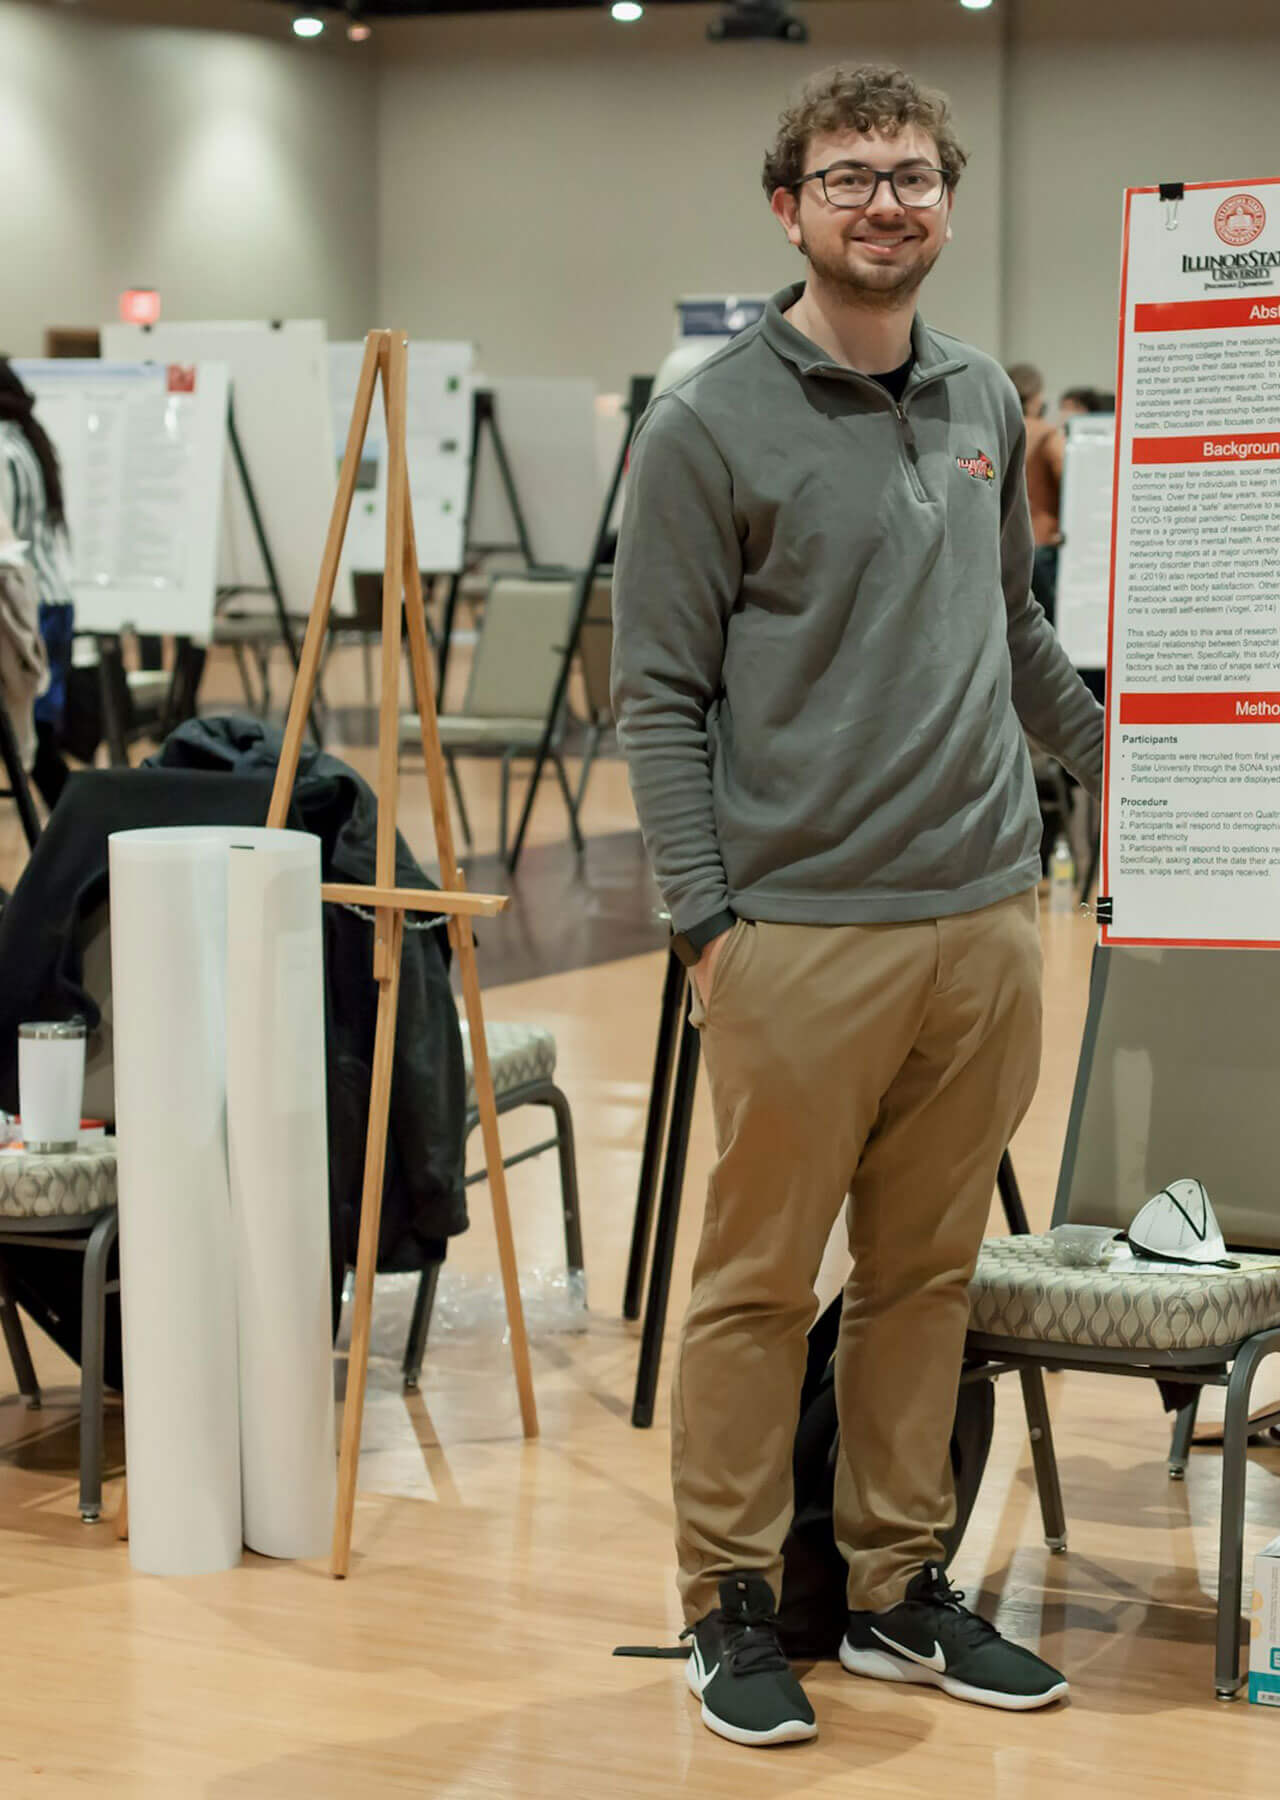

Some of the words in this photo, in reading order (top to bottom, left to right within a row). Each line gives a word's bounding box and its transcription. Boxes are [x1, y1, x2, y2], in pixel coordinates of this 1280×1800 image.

[1182, 253, 1248, 272] ILLINOIS
[1139, 342, 1154, 350] This
[1156, 341, 1176, 352] study
[1179, 338, 1223, 351] investigates
[1225, 337, 1238, 346] the
[1129, 548, 1172, 559] networking
[1174, 548, 1200, 558] majors
[1218, 547, 1240, 558] major
[1242, 546, 1278, 557] university
[1122, 734, 1178, 745] Participants
[1132, 751, 1176, 761] Participants
[1198, 751, 1233, 759] recruited
[1120, 797, 1168, 806] Procedure
